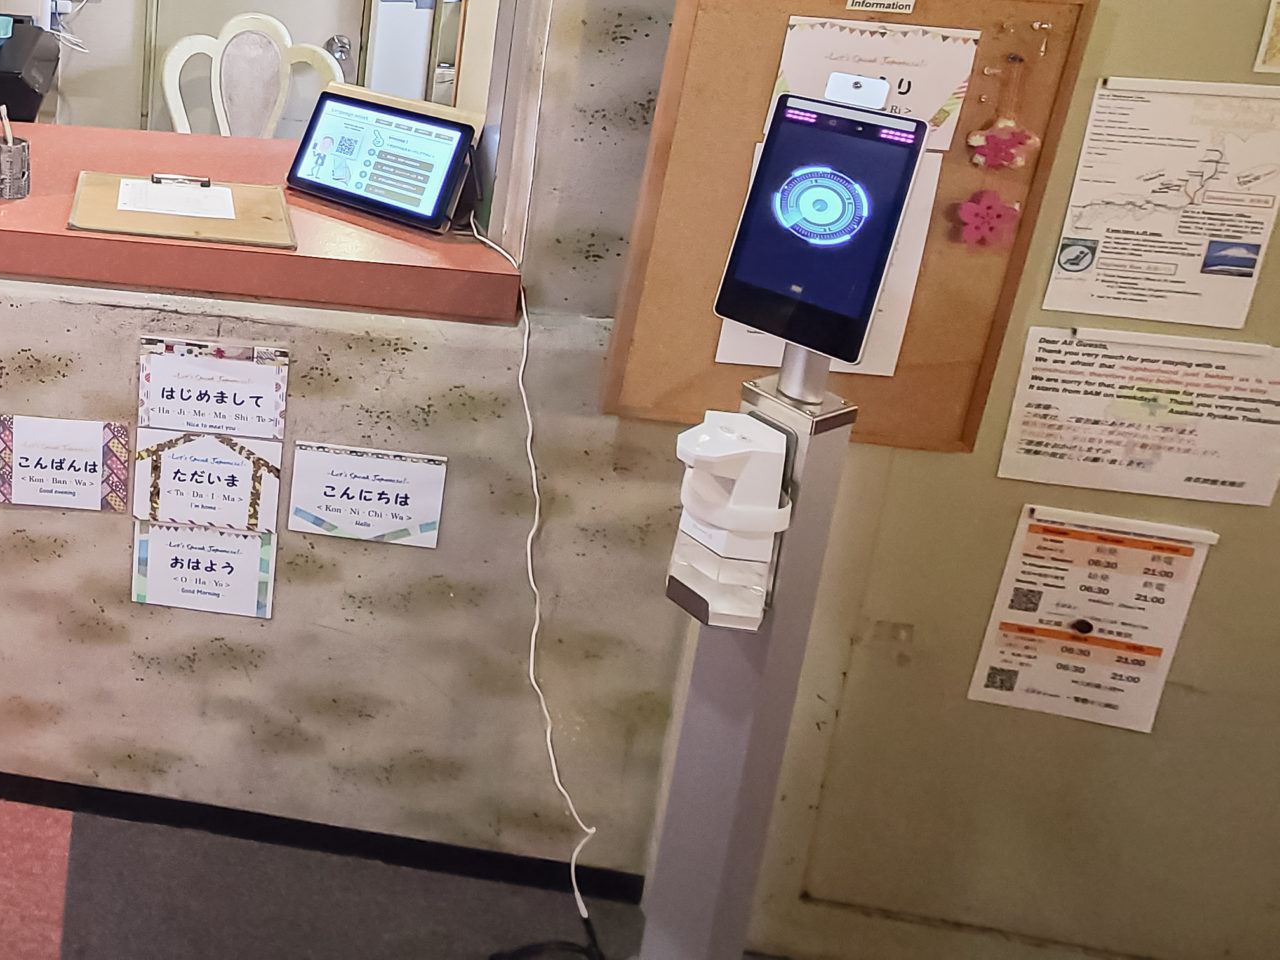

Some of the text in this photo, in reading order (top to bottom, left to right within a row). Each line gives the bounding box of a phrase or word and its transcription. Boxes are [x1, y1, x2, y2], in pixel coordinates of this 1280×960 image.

[851, 0, 911, 11] Information
[1039, 337, 1060, 345] Dear
[161, 387, 263, 407] はじめまして
[18, 456, 98, 473] こんばんは
[172, 468, 239, 487] ただいま
[323, 485, 410, 506] こんにちは
[325, 504, 404, 521] Kon Ni Chi Wa
[170, 556, 234, 575] おはよう
[1088, 558, 1174, 579] 06:30 21:00
[1079, 584, 1165, 605] 06:30 21:00
[1060, 645, 1146, 667] 06:30 21:00
[1056, 662, 1141, 684] 06:30 21:00
